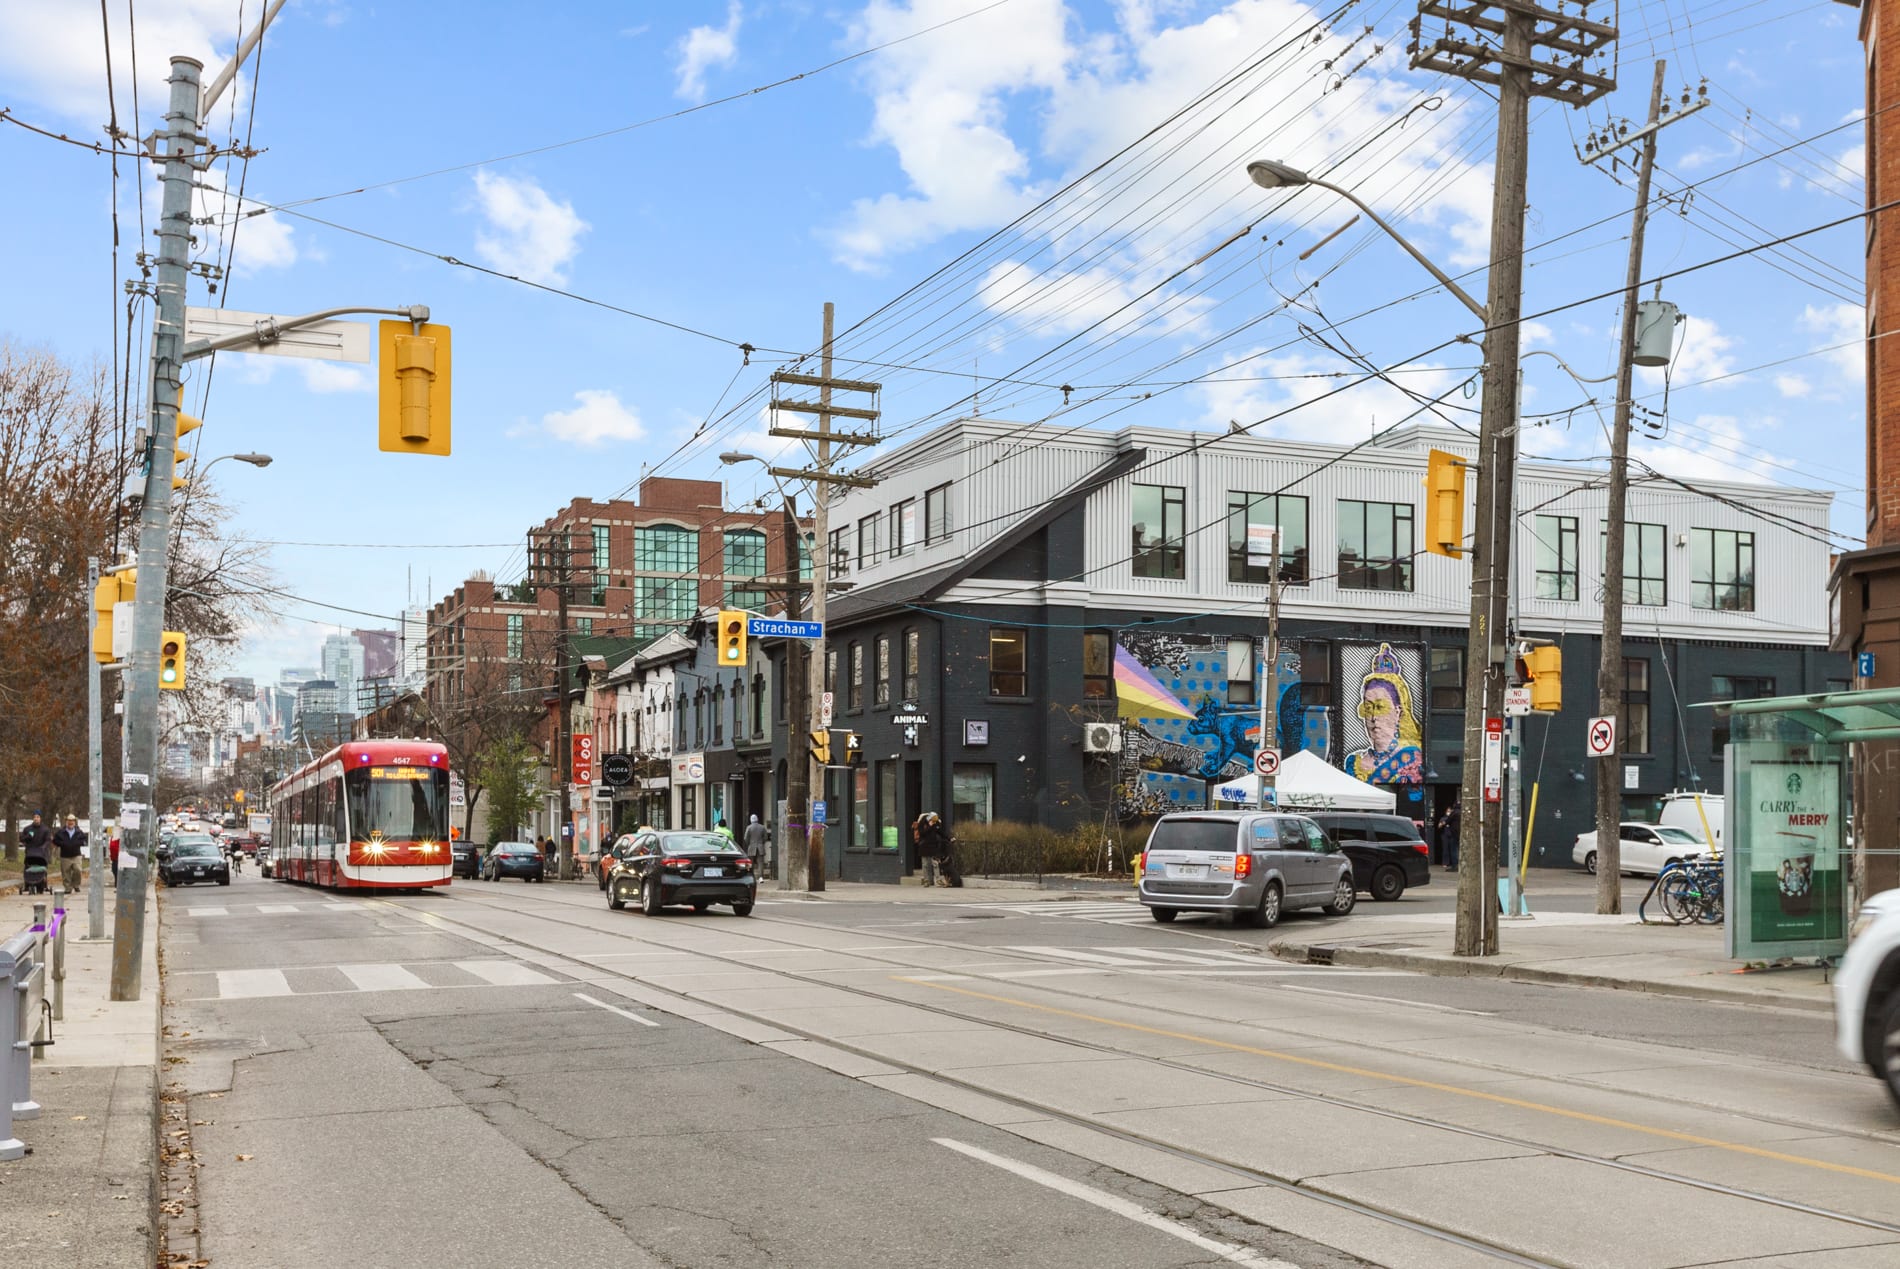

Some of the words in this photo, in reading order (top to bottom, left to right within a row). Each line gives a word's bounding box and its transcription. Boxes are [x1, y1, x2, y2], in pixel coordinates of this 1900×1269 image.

[753, 621, 806, 635] Strachan
[893, 715, 928, 724] ANIMAL
[1760, 800, 1798, 813] CARRY
[1788, 814, 1829, 826] MERRY
